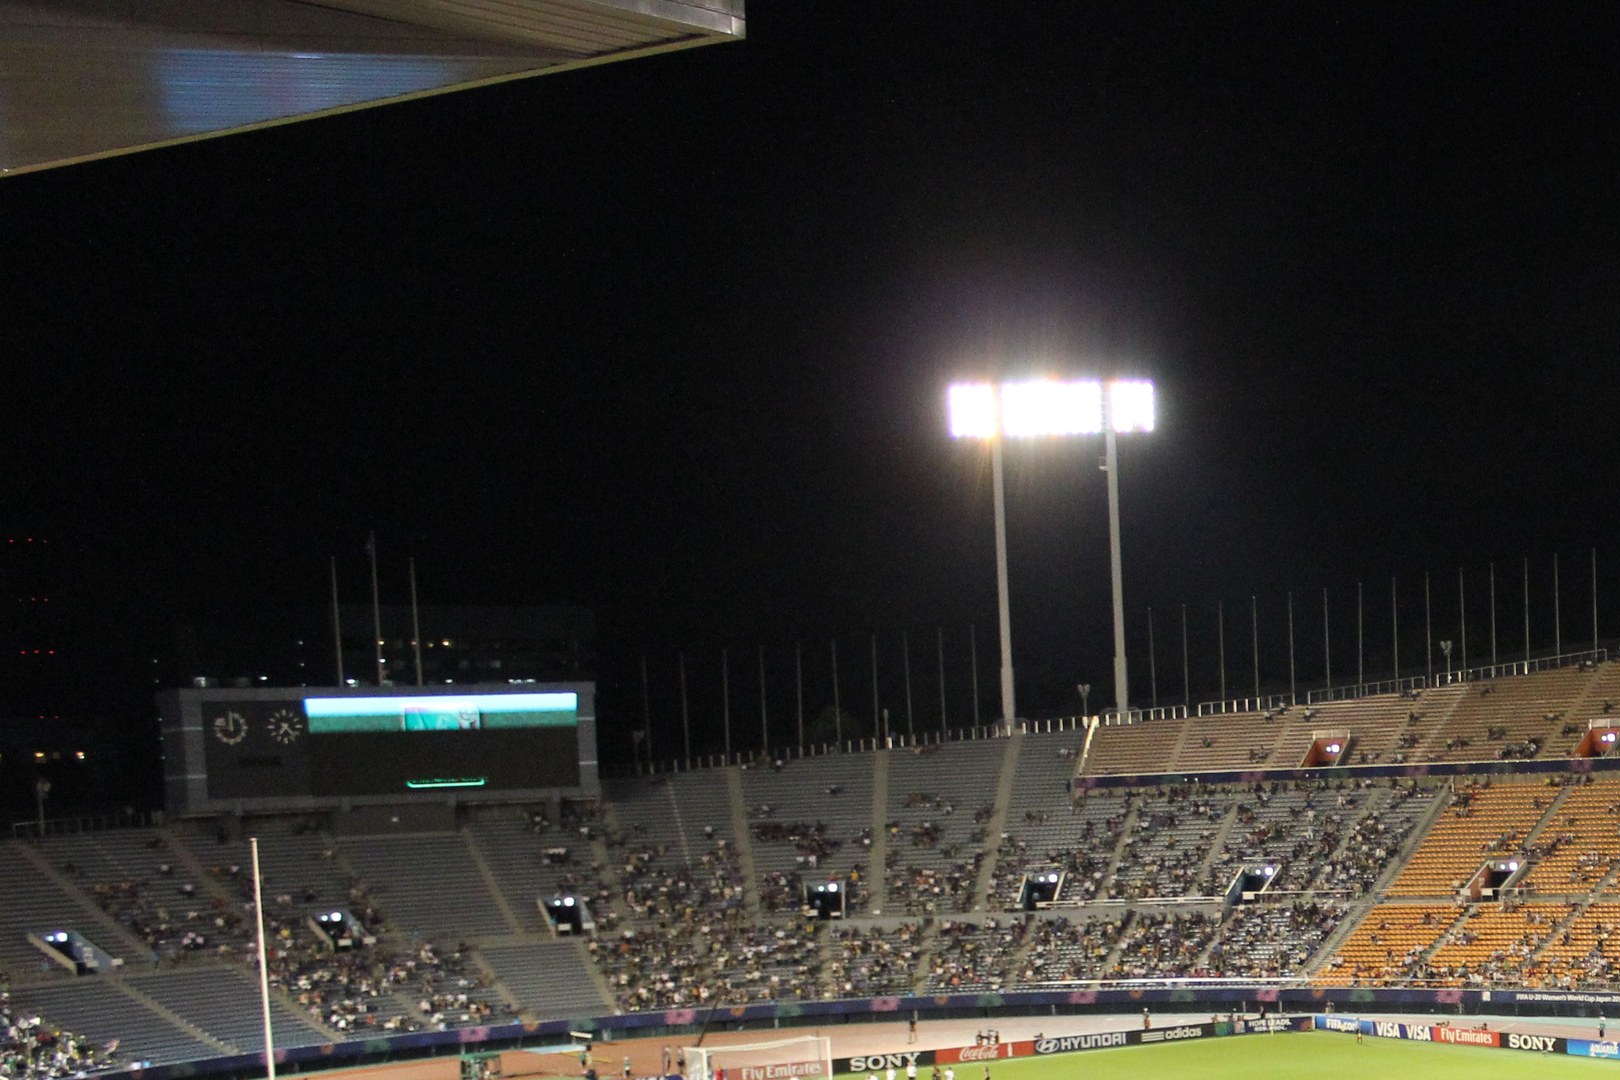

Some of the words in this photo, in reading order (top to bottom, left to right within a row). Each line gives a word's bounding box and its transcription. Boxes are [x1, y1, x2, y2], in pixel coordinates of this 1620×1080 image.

[1165, 1027, 1202, 1040] adidas
[1376, 1021, 1400, 1038] VISA
[1405, 1024, 1431, 1041] VISA
[1440, 1028, 1455, 1043] Fly
[1456, 1029, 1493, 1045] Emirates
[1061, 1032, 1127, 1050] HYUNDAI
[1508, 1033, 1556, 1051] SONY
[850, 1052, 921, 1072] SONY
[741, 1067, 764, 1080] Fly
[767, 1062, 823, 1079] Emirates
